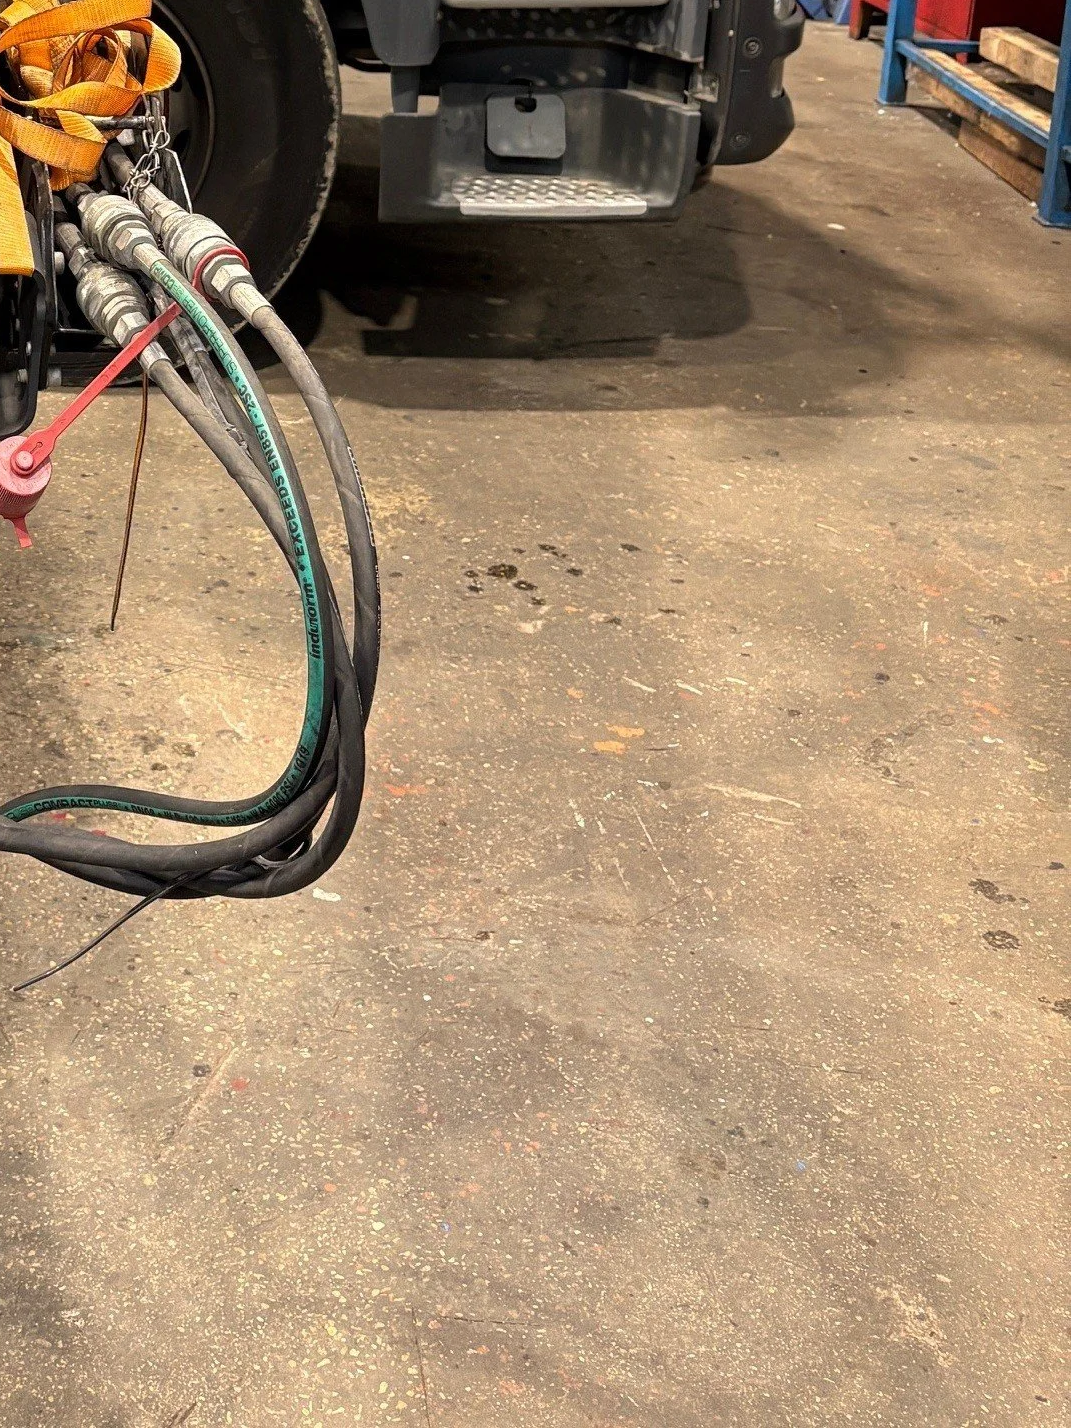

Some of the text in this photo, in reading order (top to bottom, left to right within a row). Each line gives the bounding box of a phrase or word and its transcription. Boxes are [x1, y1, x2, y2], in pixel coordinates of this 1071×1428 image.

[238, 384, 257, 413] 2SC
[254, 423, 281, 472] EN857
[273, 474, 306, 557] EXCEEDS
[303, 582, 321, 660] indunorm
